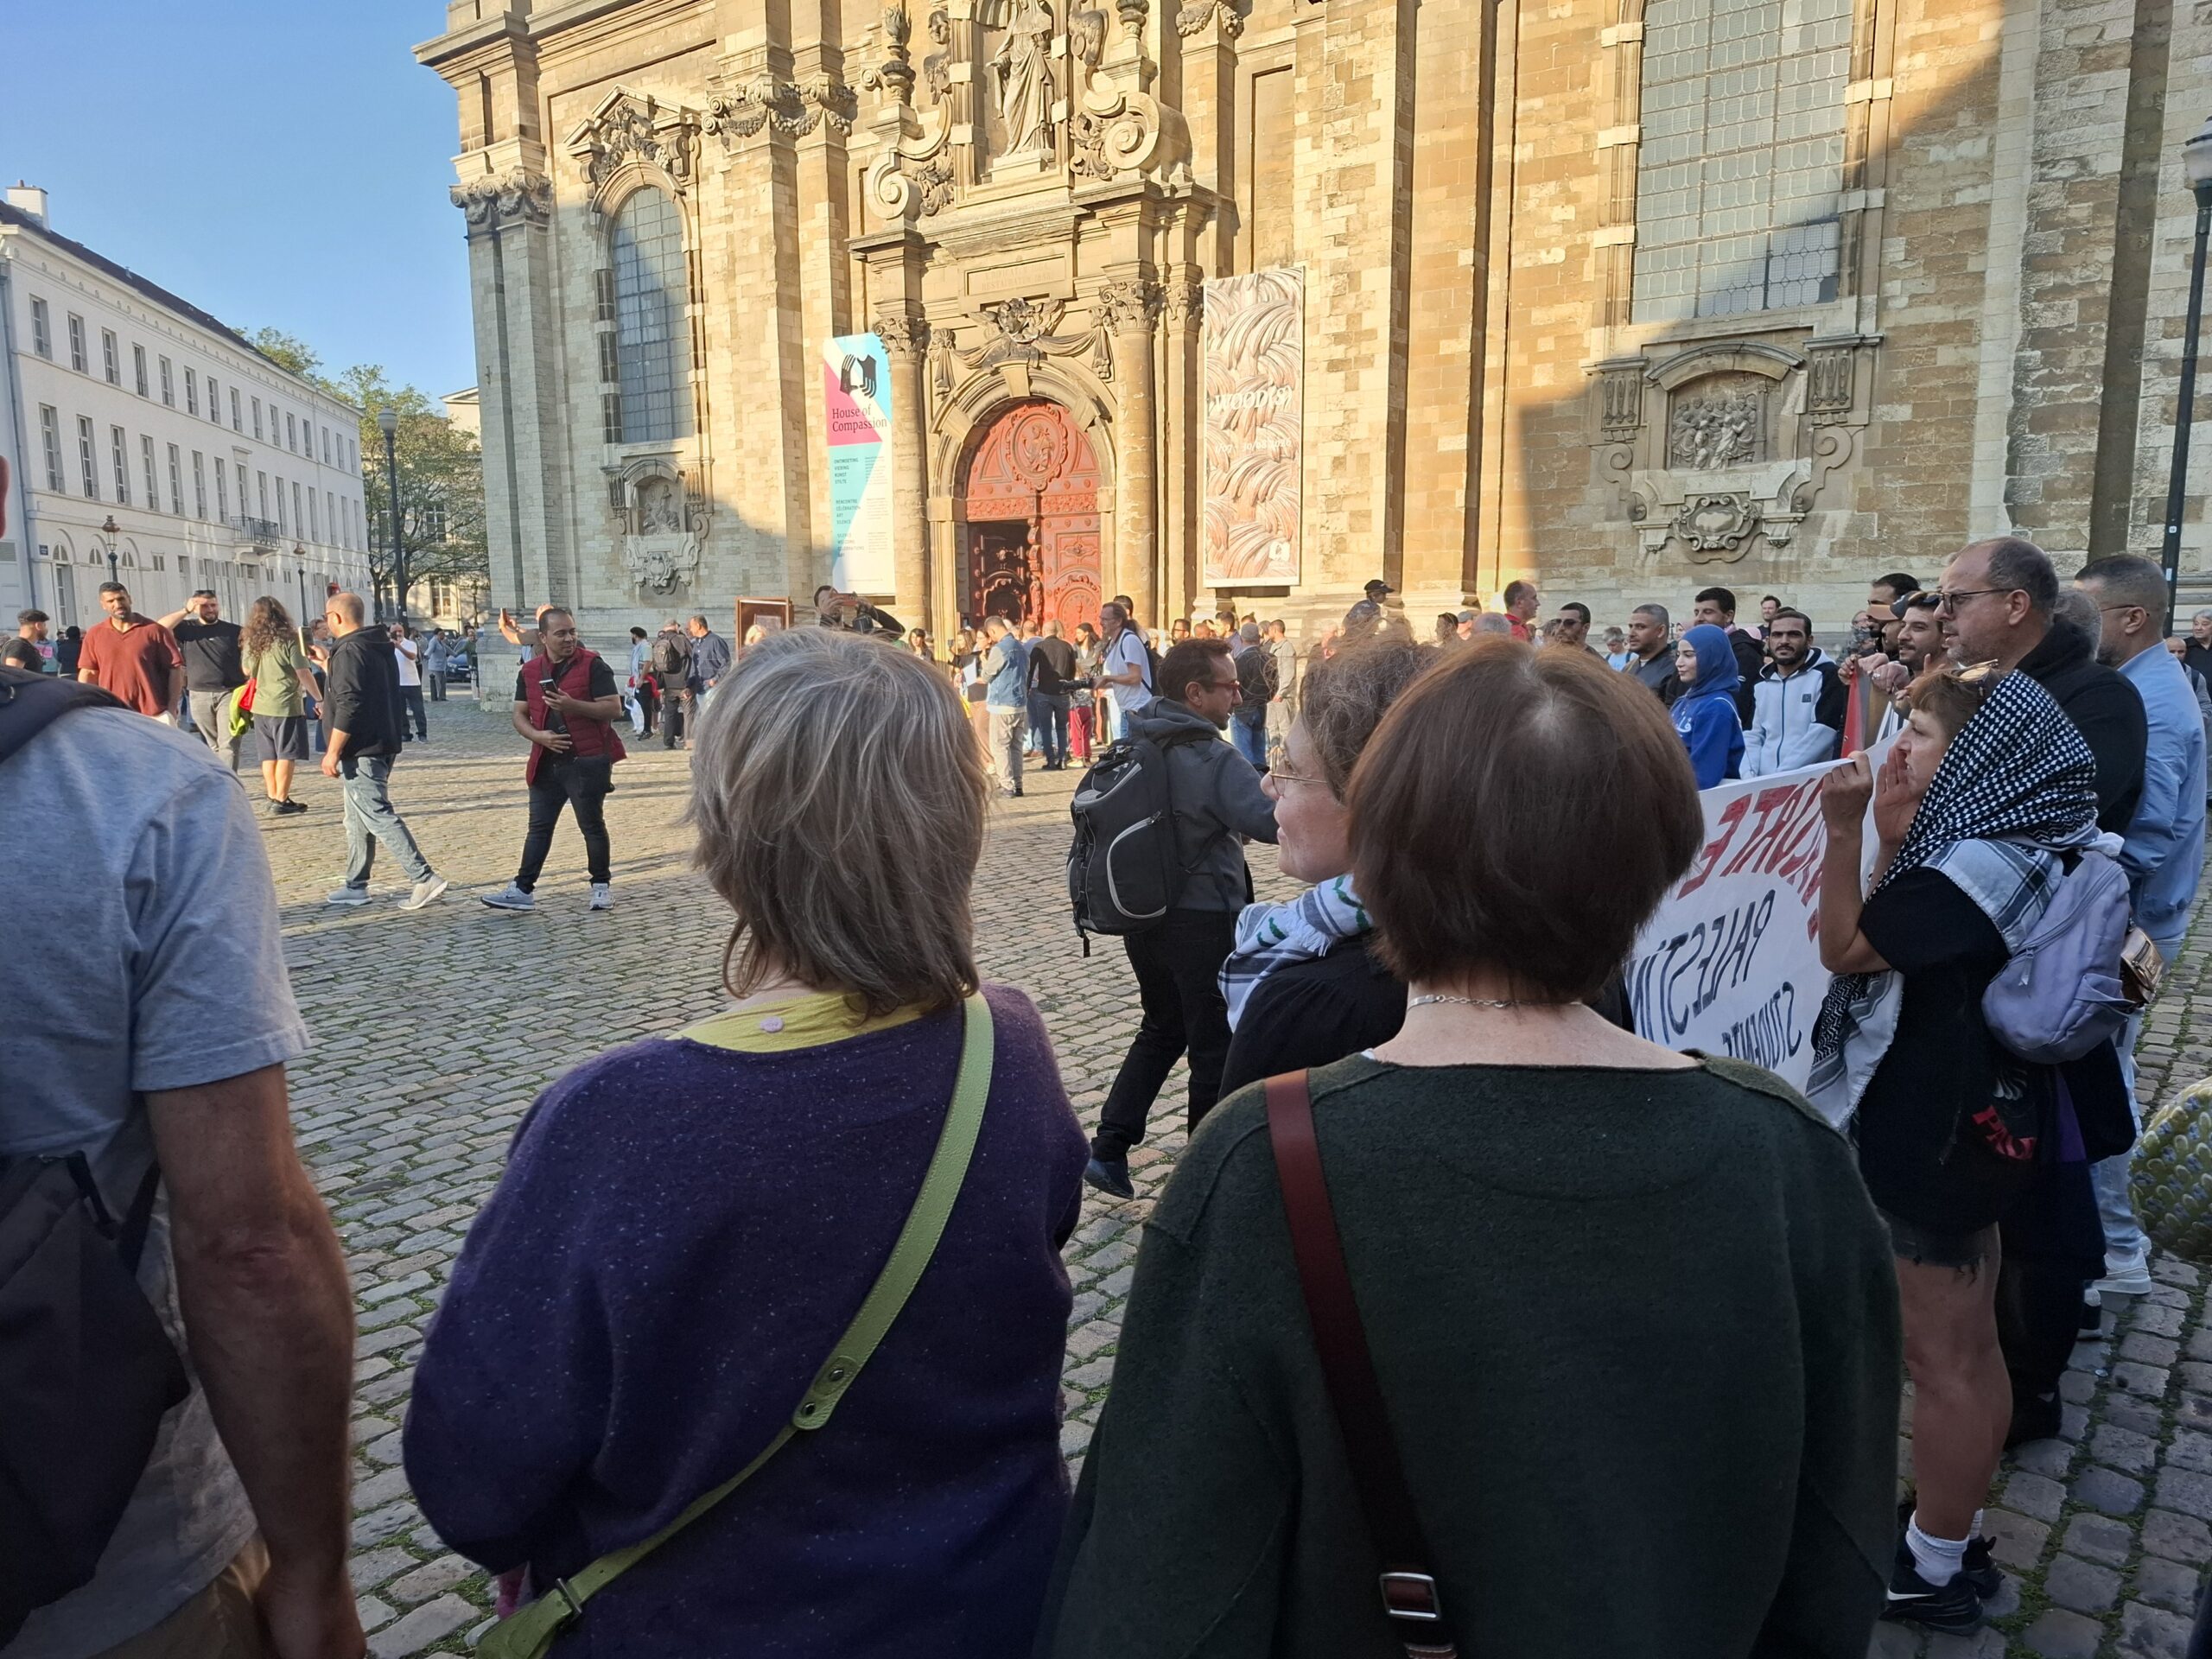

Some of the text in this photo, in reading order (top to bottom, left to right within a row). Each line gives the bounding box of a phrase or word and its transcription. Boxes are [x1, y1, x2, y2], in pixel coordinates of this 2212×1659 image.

[832, 404, 872, 419] House of
[832, 417, 887, 433] Compassion
